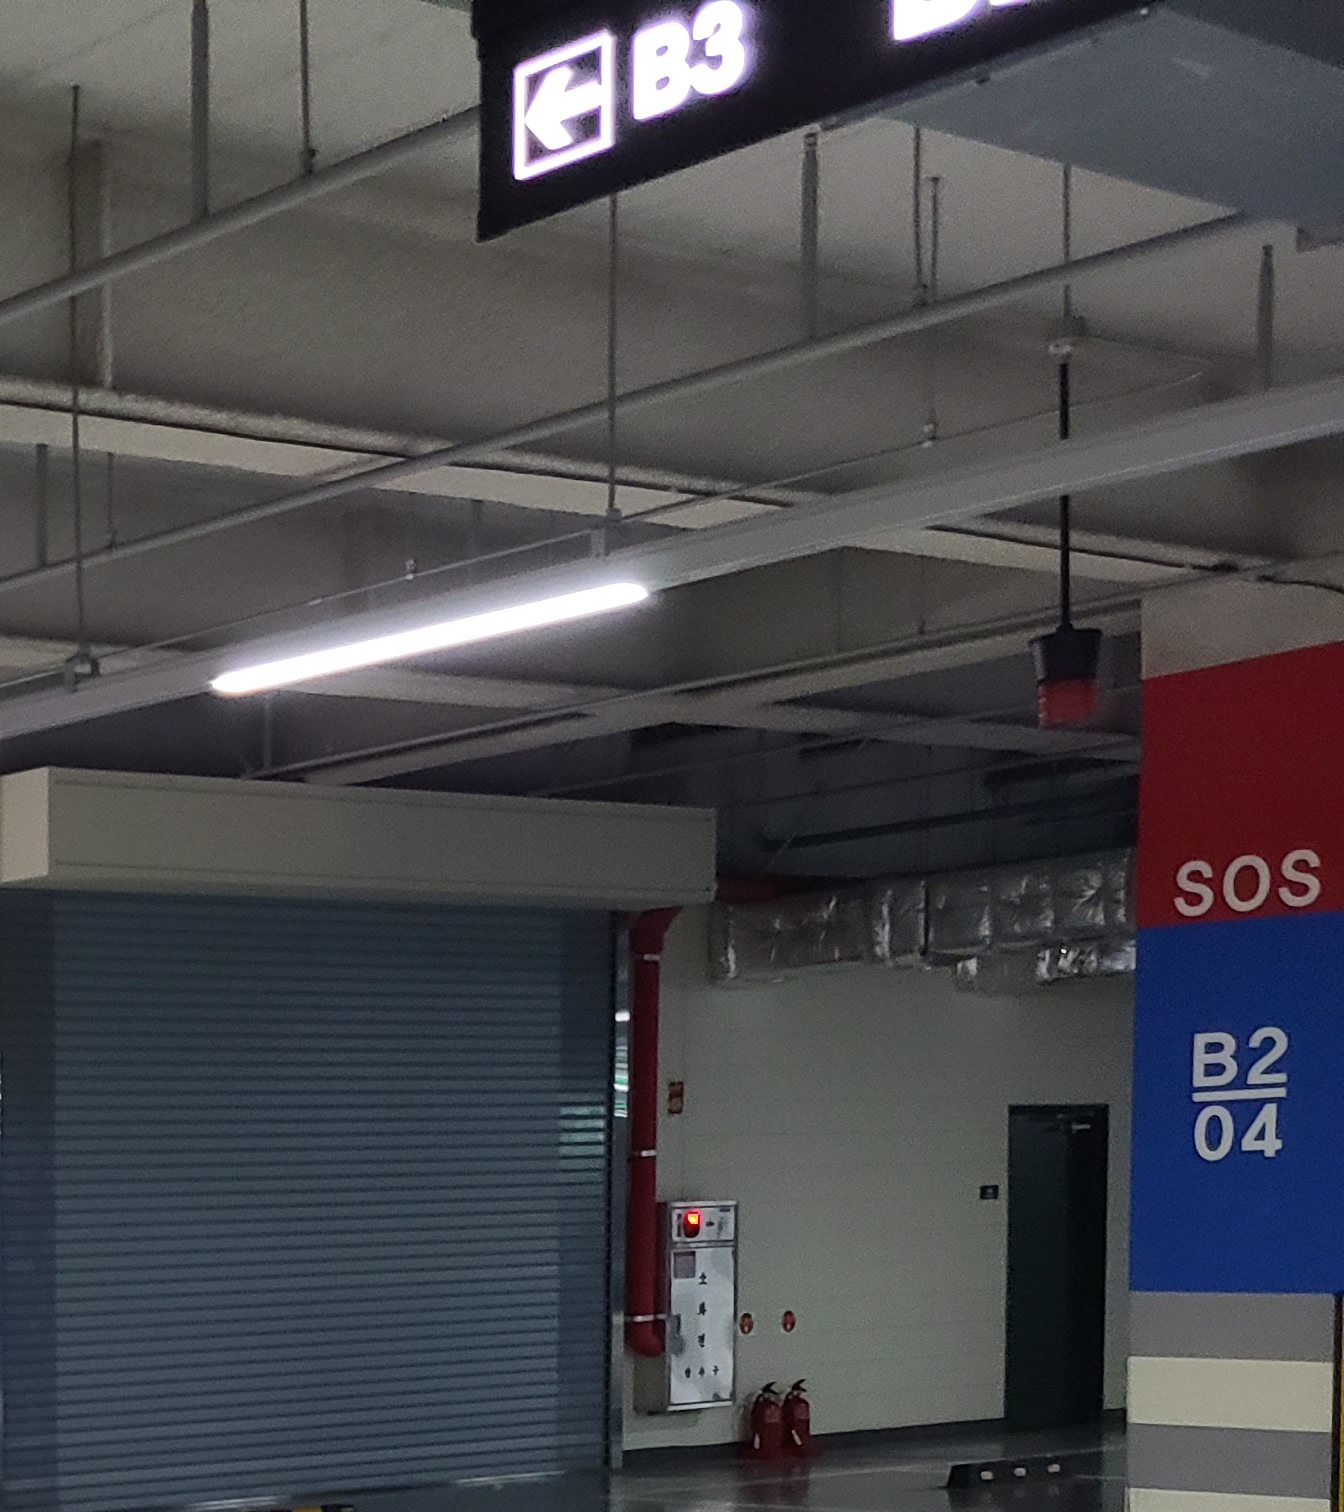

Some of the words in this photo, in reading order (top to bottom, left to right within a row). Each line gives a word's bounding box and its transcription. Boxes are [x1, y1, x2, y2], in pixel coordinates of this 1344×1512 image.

[632, 0, 746, 121] B3
[1174, 849, 1322, 917] SOS
[1192, 1026, 1289, 1088] B2
[1193, 1102, 1283, 1162] 04
